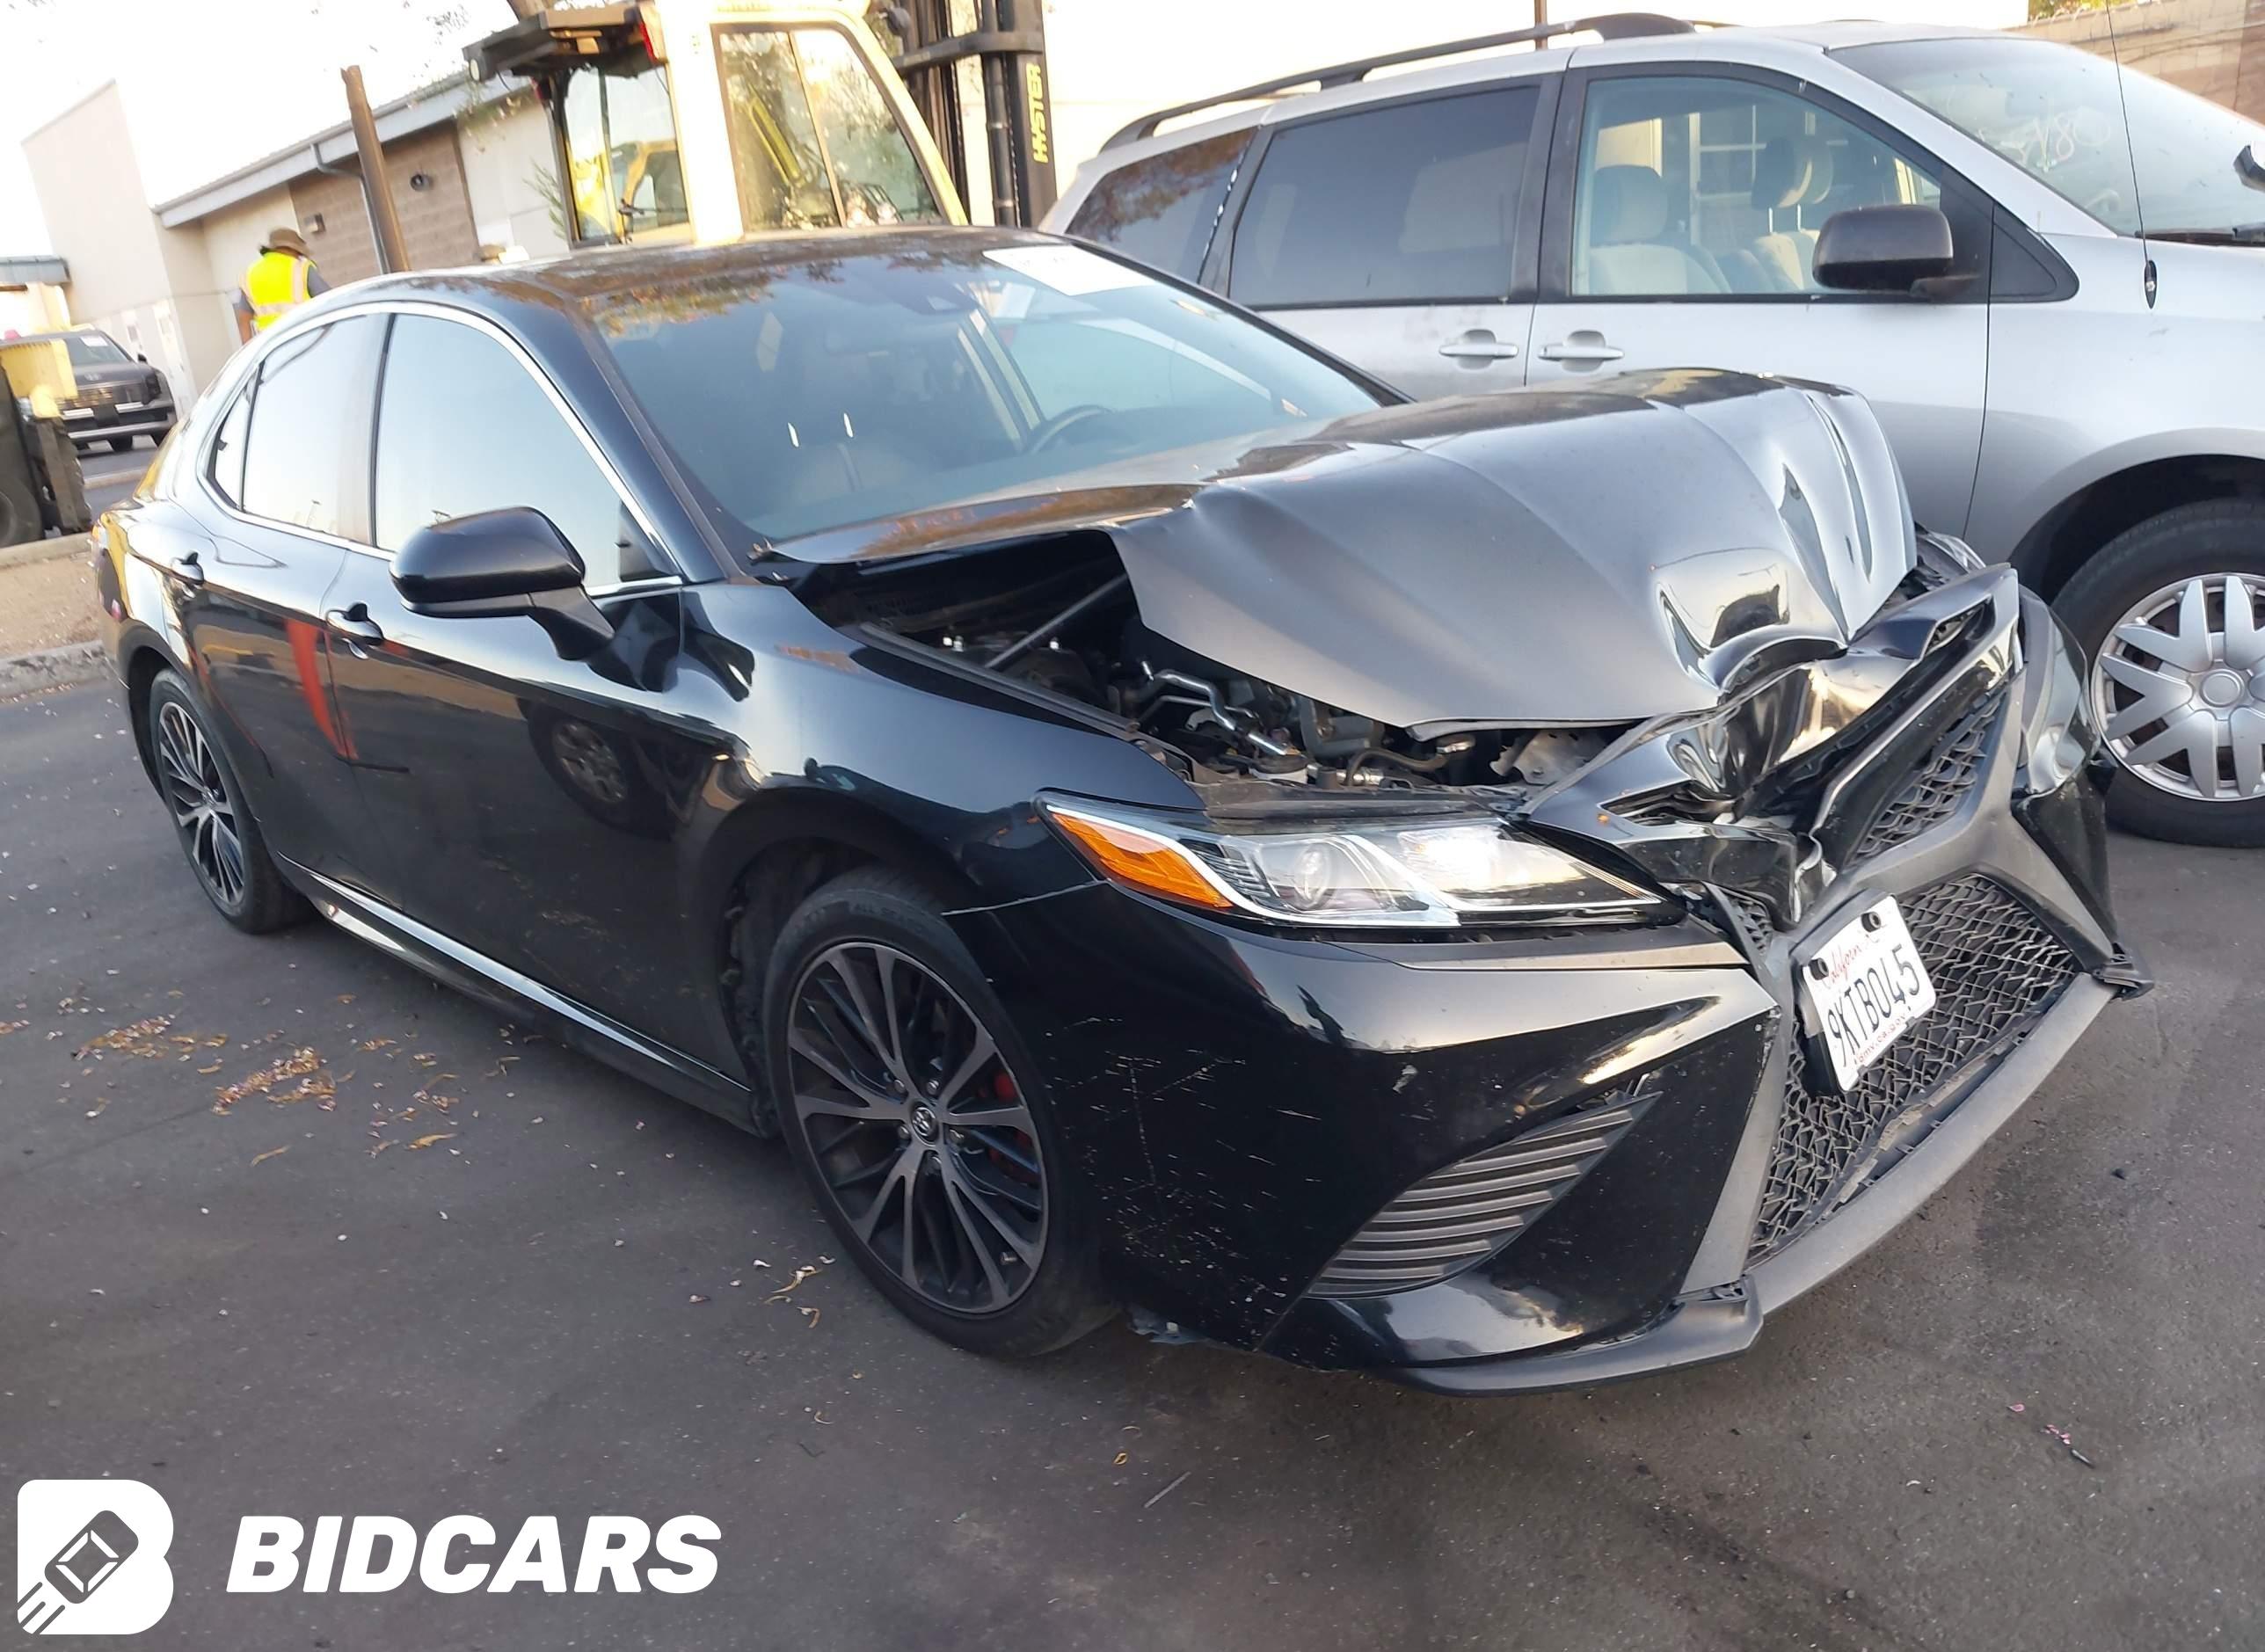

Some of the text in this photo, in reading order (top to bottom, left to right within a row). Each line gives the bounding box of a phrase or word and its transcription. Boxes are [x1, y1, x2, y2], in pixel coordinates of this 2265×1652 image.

[1026, 62, 1048, 164] HYSTER
[1821, 941, 1869, 990] aliforn
[1828, 943, 1920, 1067] 9KTB045
